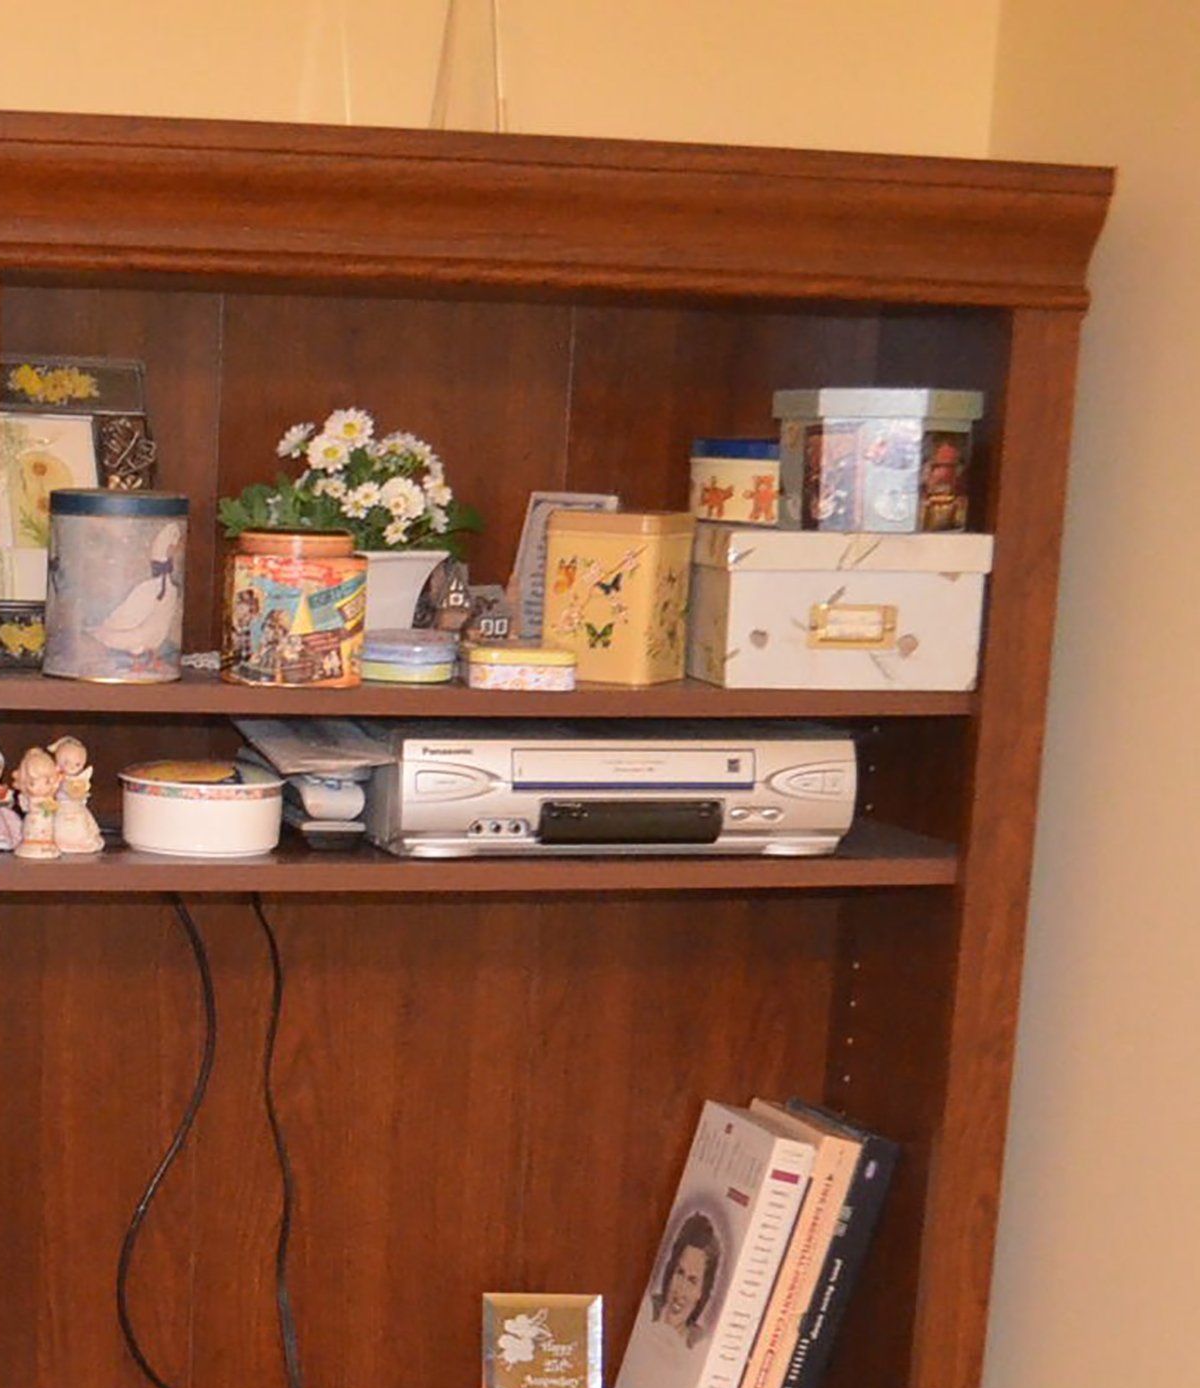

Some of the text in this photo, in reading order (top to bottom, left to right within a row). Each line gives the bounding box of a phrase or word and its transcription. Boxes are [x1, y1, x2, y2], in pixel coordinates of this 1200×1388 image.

[422, 747, 473, 755] Panasonic
[717, 1307, 751, 1364] CLINE
[738, 1188, 790, 1299] COLLECTION
